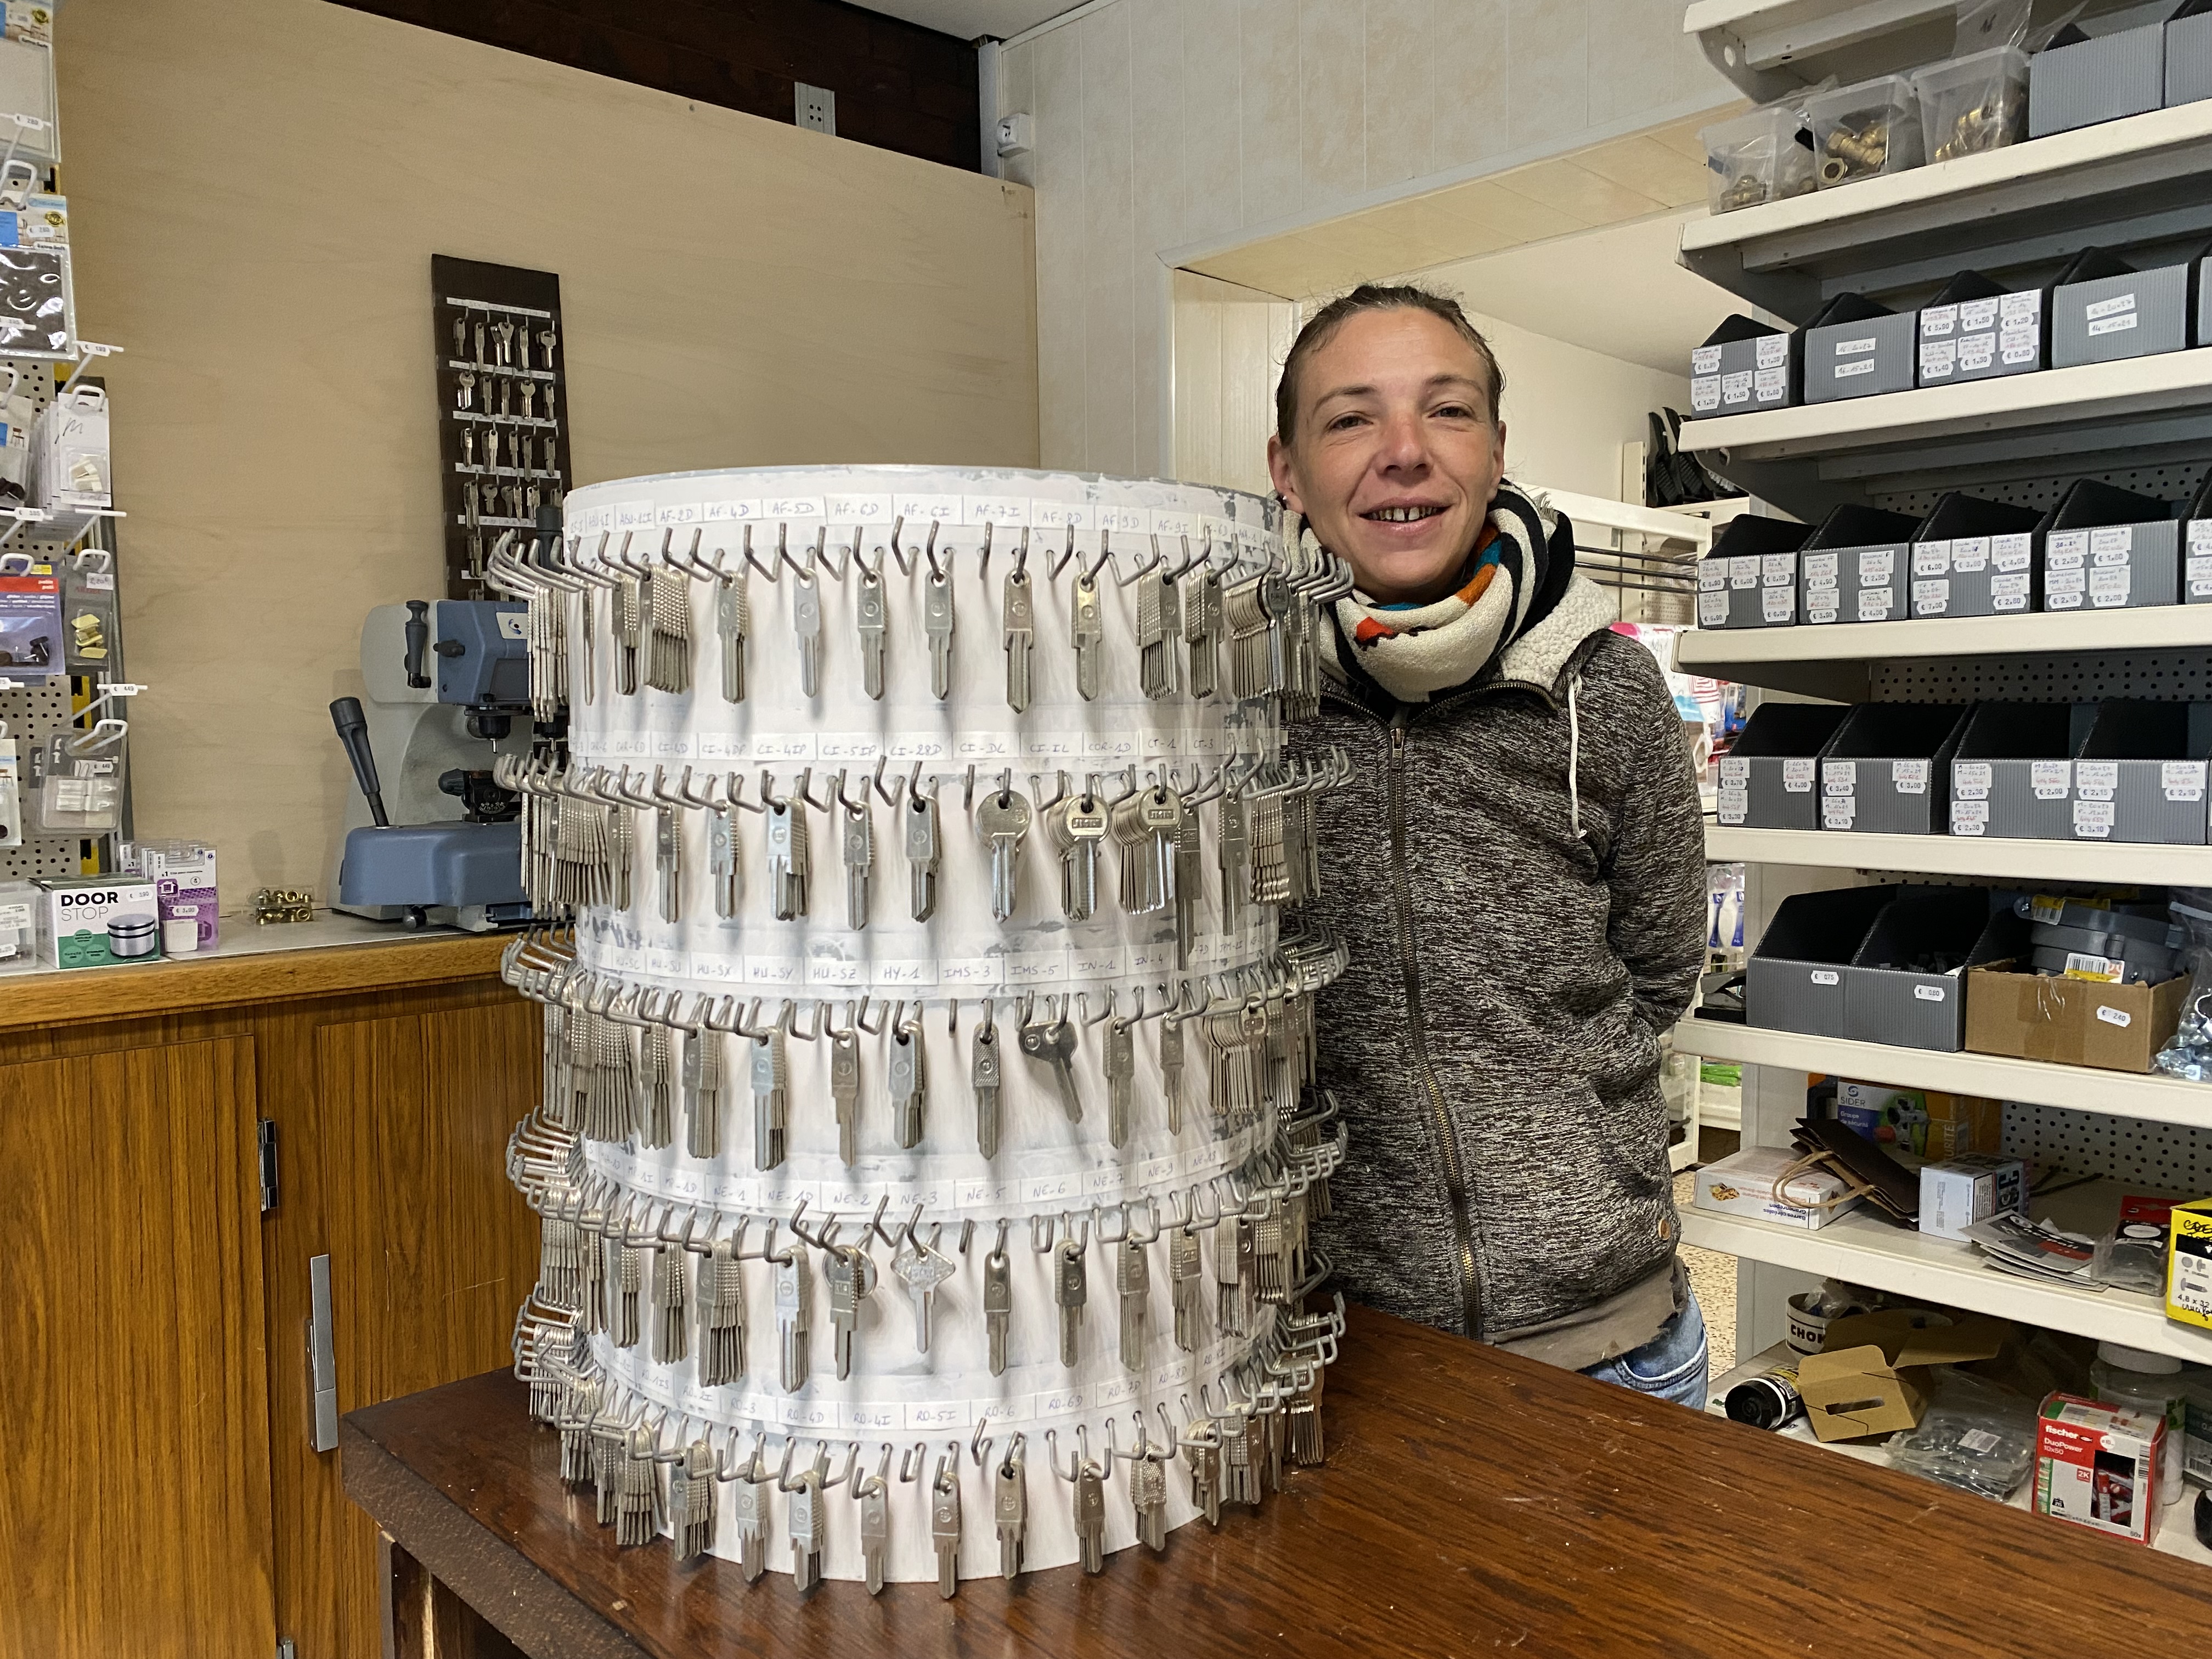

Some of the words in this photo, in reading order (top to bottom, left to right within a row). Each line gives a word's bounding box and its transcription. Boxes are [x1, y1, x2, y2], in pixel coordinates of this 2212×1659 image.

[709, 504, 750, 518] AF-4D
[834, 503, 879, 516] AF-6D
[975, 505, 1021, 517] AF-7I
[1102, 515, 1139, 528] AF-9D
[1158, 520, 1189, 534] AF-9I
[757, 744, 807, 755] CI-4IP
[822, 744, 877, 755] CI-5IP
[1148, 738, 1177, 749] CT-1
[1193, 738, 1214, 749] CT-3
[60, 891, 119, 907] DOOR
[60, 906, 109, 922] STOP
[1077, 960, 1116, 972] IN-1
[1135, 954, 1164, 966] IN-4
[884, 966, 921, 979] HY-1
[944, 966, 990, 978] IMS-3
[1010, 964, 1059, 976] IMS-5
[1840, 1097, 1866, 1107] SIDER
[1093, 1173, 1125, 1187] NE-7
[967, 1186, 1006, 1201] NE-5
[1033, 1182, 1066, 1198] NE-6
[833, 1192, 871, 1206] NE-2
[900, 1191, 939, 1205] NE-3
[916, 1410, 957, 1422] RO-5I
[2045, 1424, 2079, 1440] fischer
[2044, 1437, 2083, 1453] DuoPower
[2078, 1469, 2090, 1480] 2K
